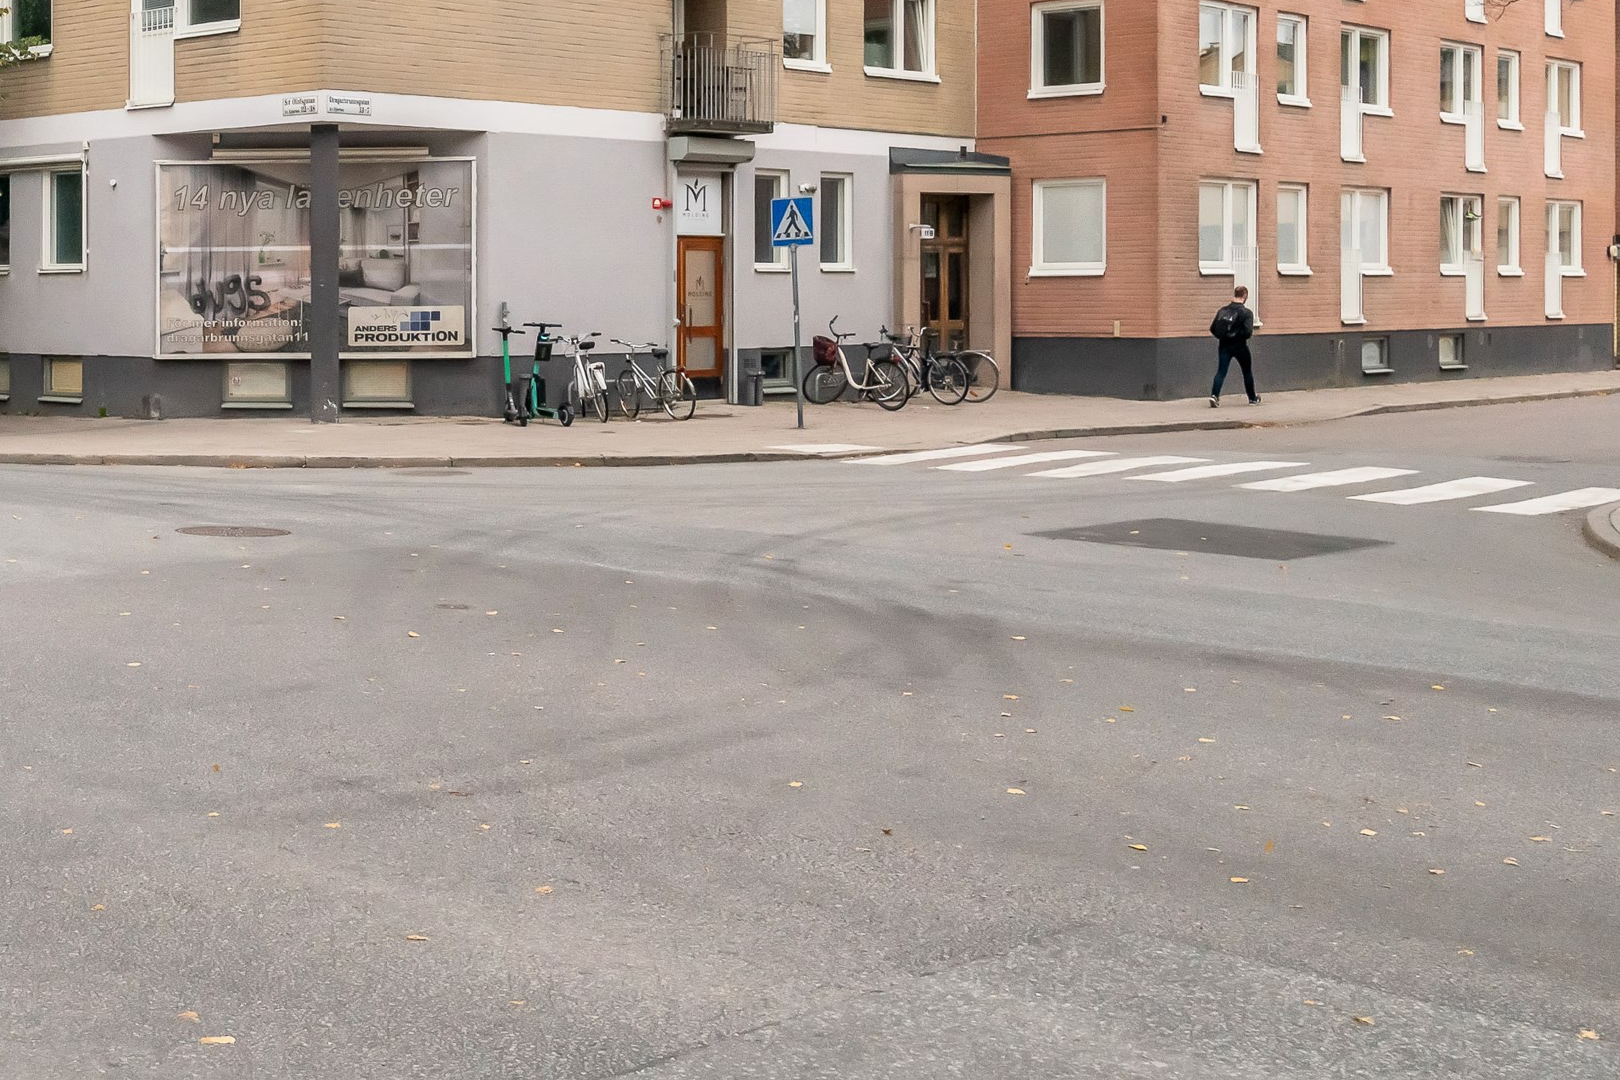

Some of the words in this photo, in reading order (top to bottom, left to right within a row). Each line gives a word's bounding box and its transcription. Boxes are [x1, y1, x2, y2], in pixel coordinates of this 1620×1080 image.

[174, 184, 209, 210] 14
[218, 187, 275, 218] nya
[285, 183, 459, 209] läenheter
[192, 319, 218, 328] mer
[221, 317, 302, 328] information:
[354, 330, 459, 342] PRODUKTION
